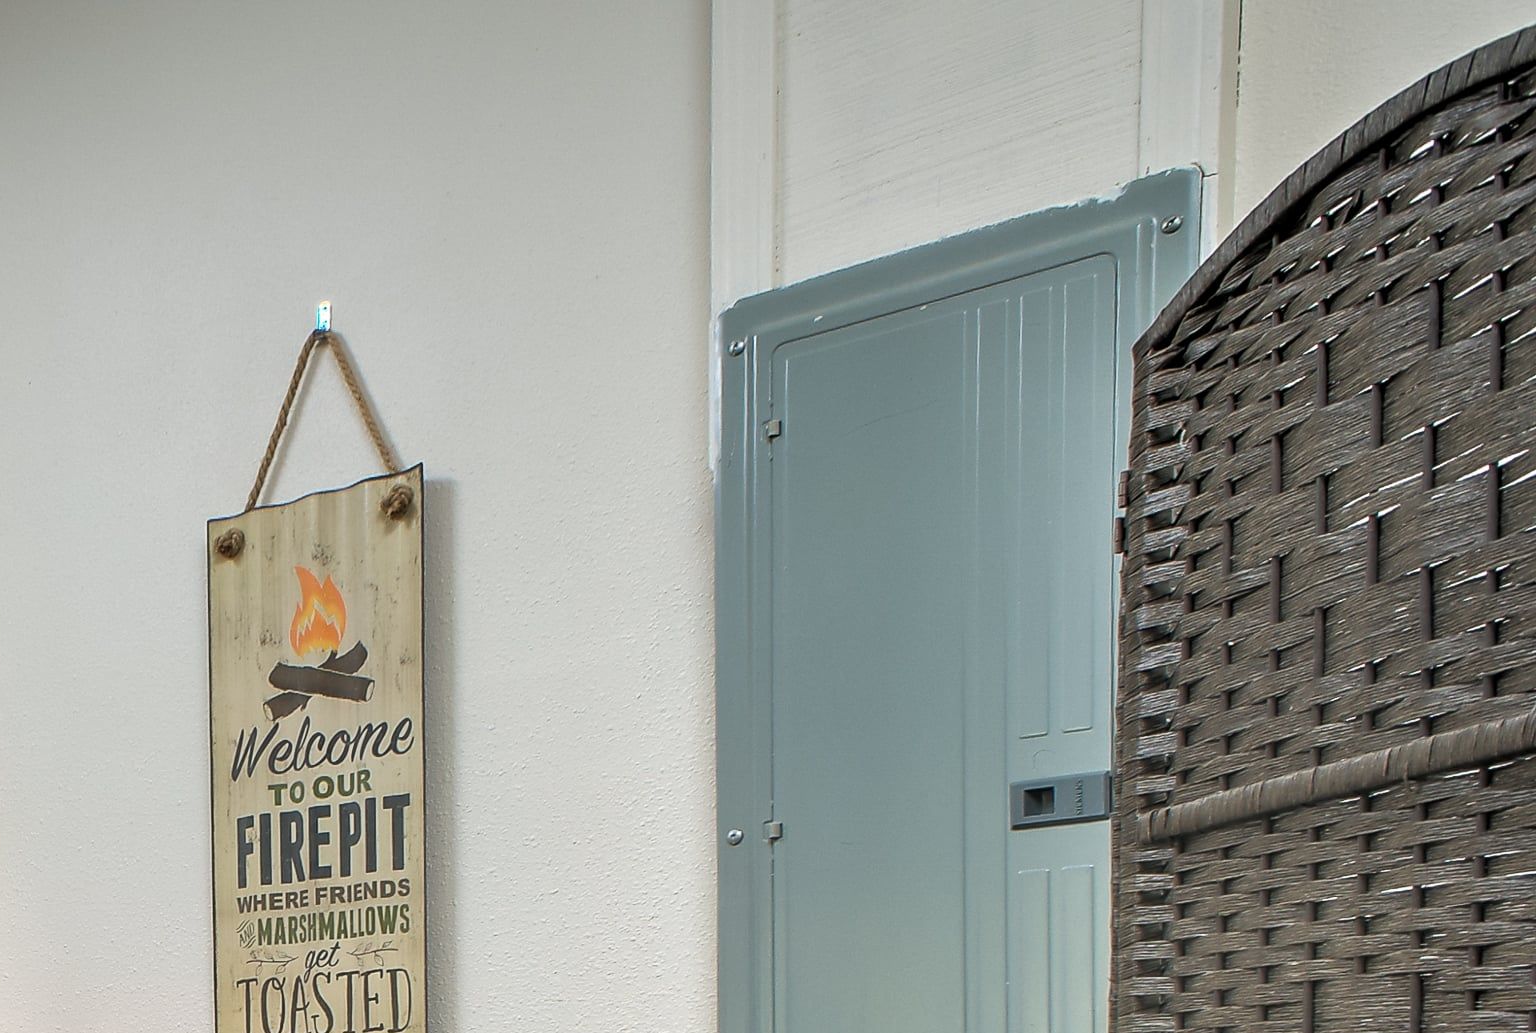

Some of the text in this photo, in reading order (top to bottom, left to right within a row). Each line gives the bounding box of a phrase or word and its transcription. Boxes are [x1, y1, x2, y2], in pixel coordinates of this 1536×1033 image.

[231, 716, 414, 782] Welcome
[267, 769, 372, 806] TO OUR
[237, 793, 411, 889] FIREPIT
[236, 878, 411, 914] WHERE FRIENDS
[257, 904, 410, 946] MARSHMALLOWS
[304, 941, 341, 983] get
